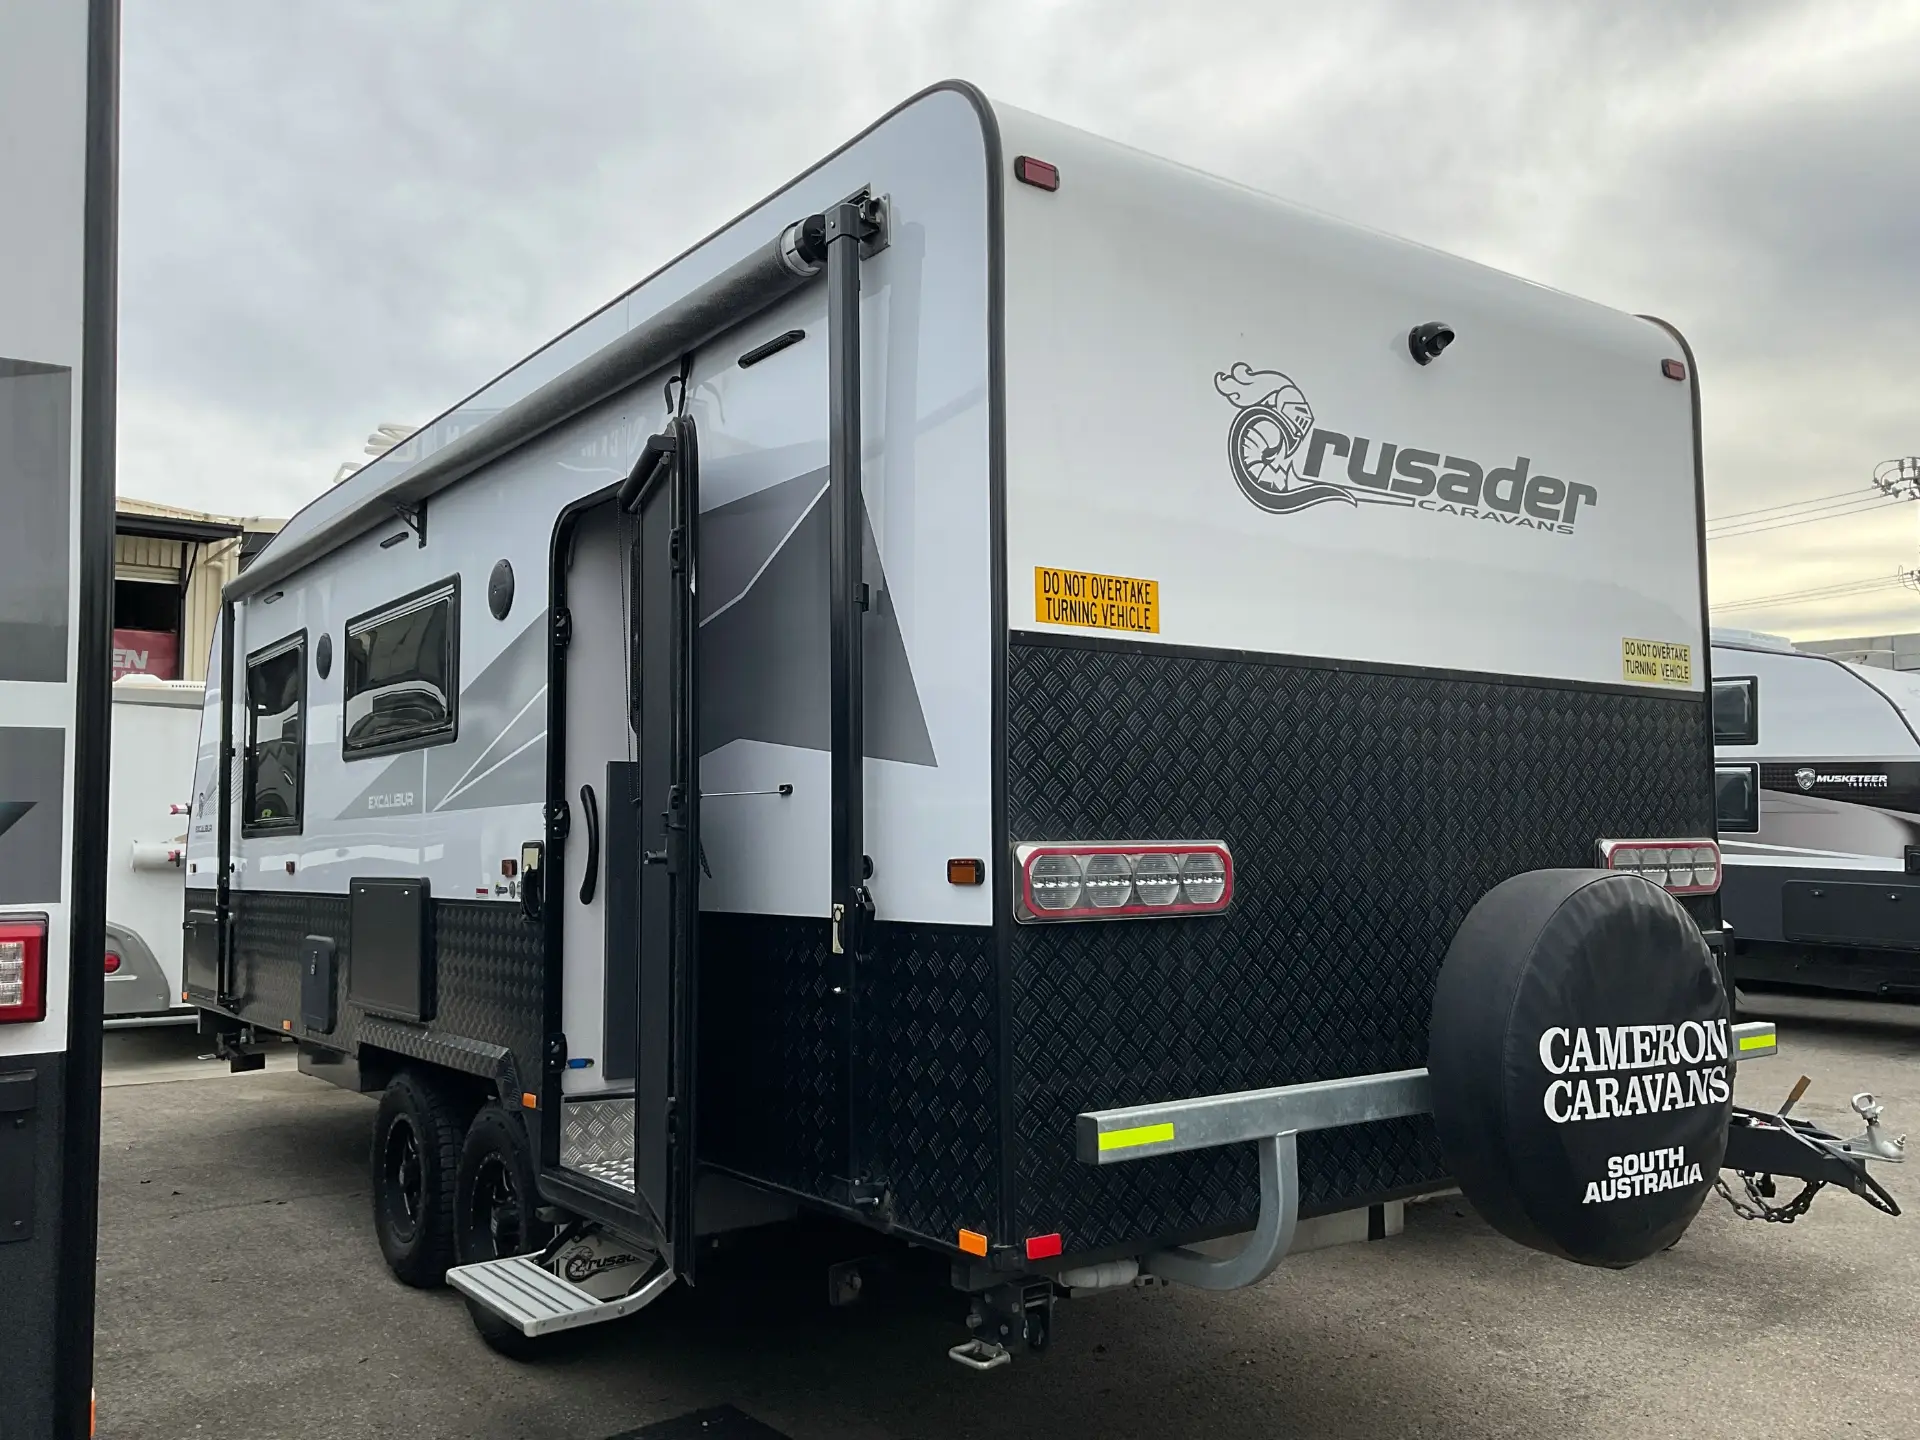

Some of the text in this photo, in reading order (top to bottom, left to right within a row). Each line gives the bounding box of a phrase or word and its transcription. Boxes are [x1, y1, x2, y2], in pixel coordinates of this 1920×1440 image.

[1228, 404, 1597, 524] Crusader
[1418, 500, 1575, 536] CARAVANS
[1043, 570, 1152, 605] DO NOT OVERTAKE
[1045, 597, 1151, 630] TURNING VEHICLE
[1625, 641, 1688, 662] DO NOT OVERTAKE
[1625, 659, 1689, 680] TURNING VEHICLE
[1816, 774, 1888, 783] MUSKETEER
[368, 792, 414, 810] EXCALIBUR
[1538, 1018, 1729, 1075] CAMERON
[1543, 1065, 1730, 1124] CARAVANS
[1607, 1145, 1685, 1179] SOUTH
[1582, 1162, 1704, 1204] AUSTRALIA
